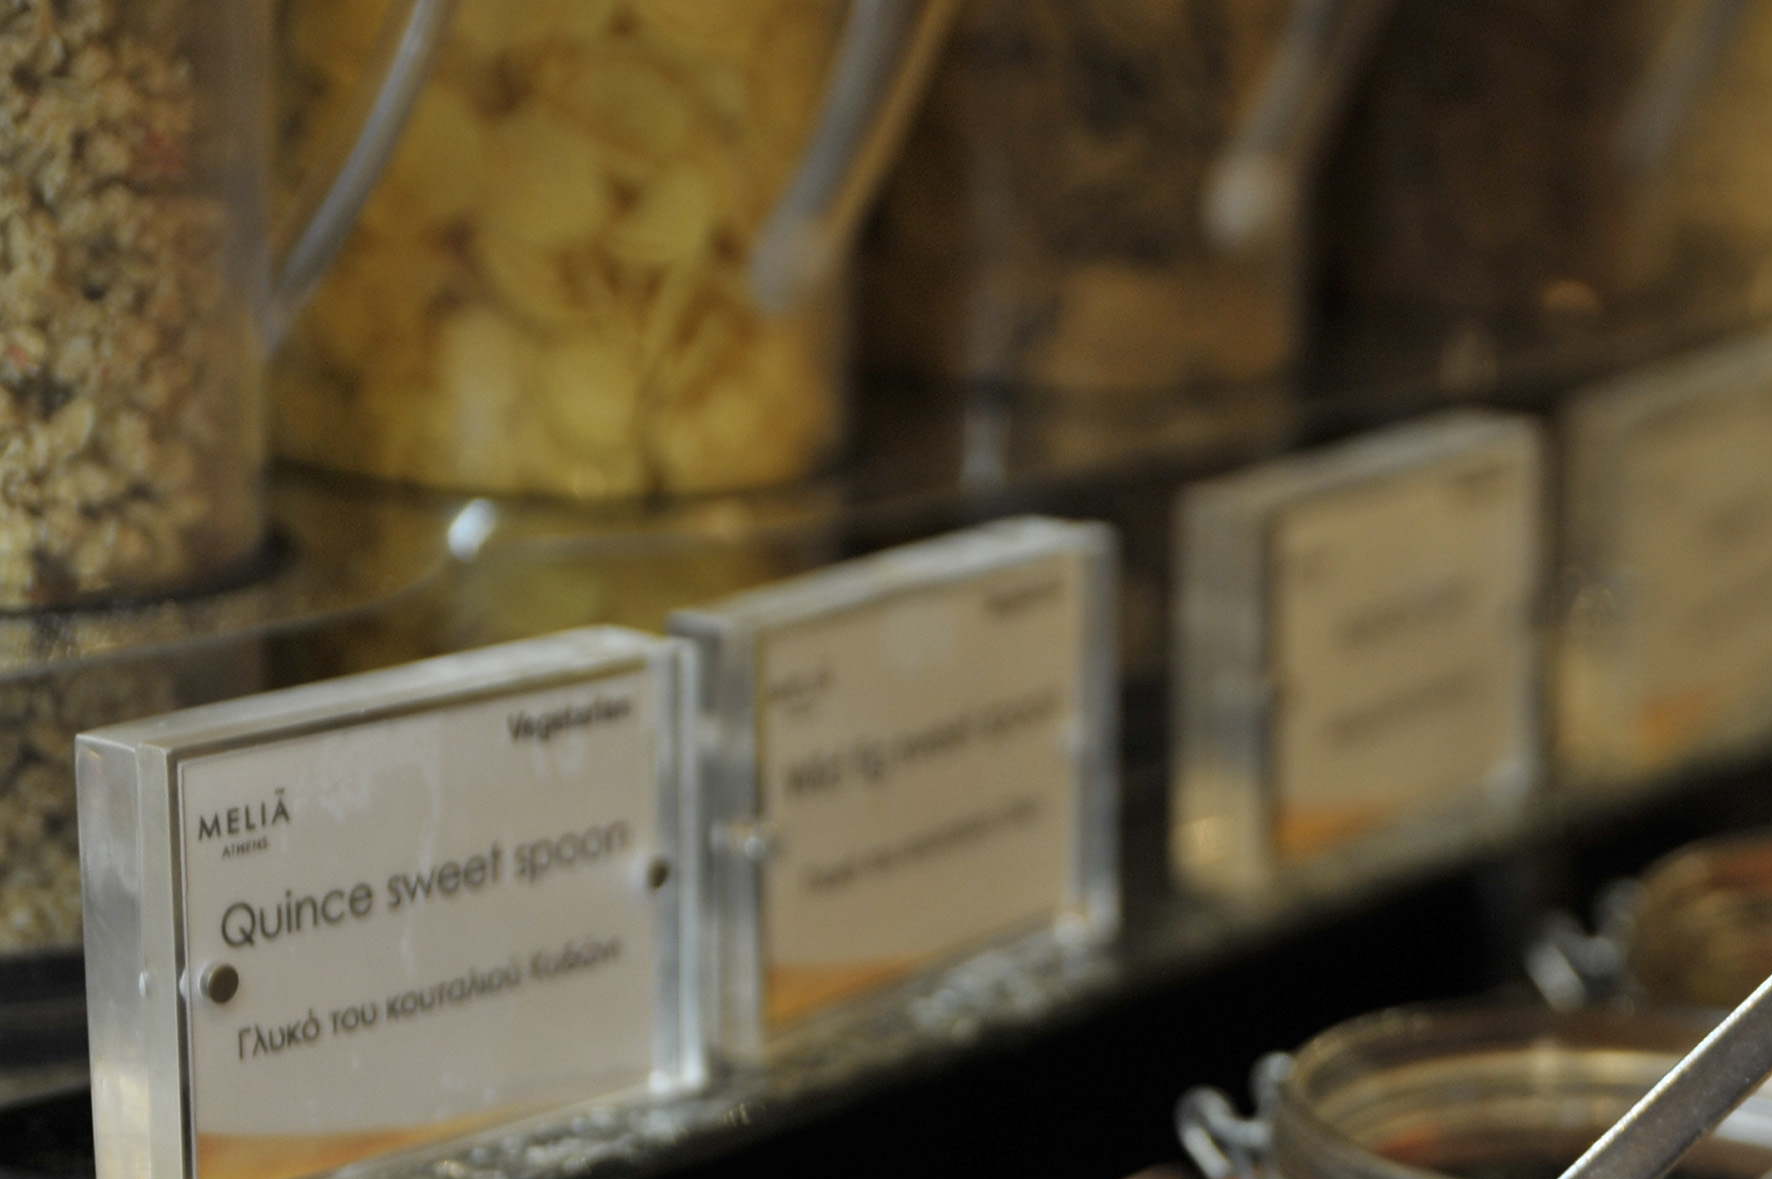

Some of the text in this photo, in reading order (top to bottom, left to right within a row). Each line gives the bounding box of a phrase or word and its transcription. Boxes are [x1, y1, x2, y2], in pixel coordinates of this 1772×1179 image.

[220, 820, 630, 949] Quince sweet spoon
[236, 1008, 320, 1060] Γλυκό
[329, 1003, 378, 1034] του
[385, 954, 523, 1021] κουταλιού
